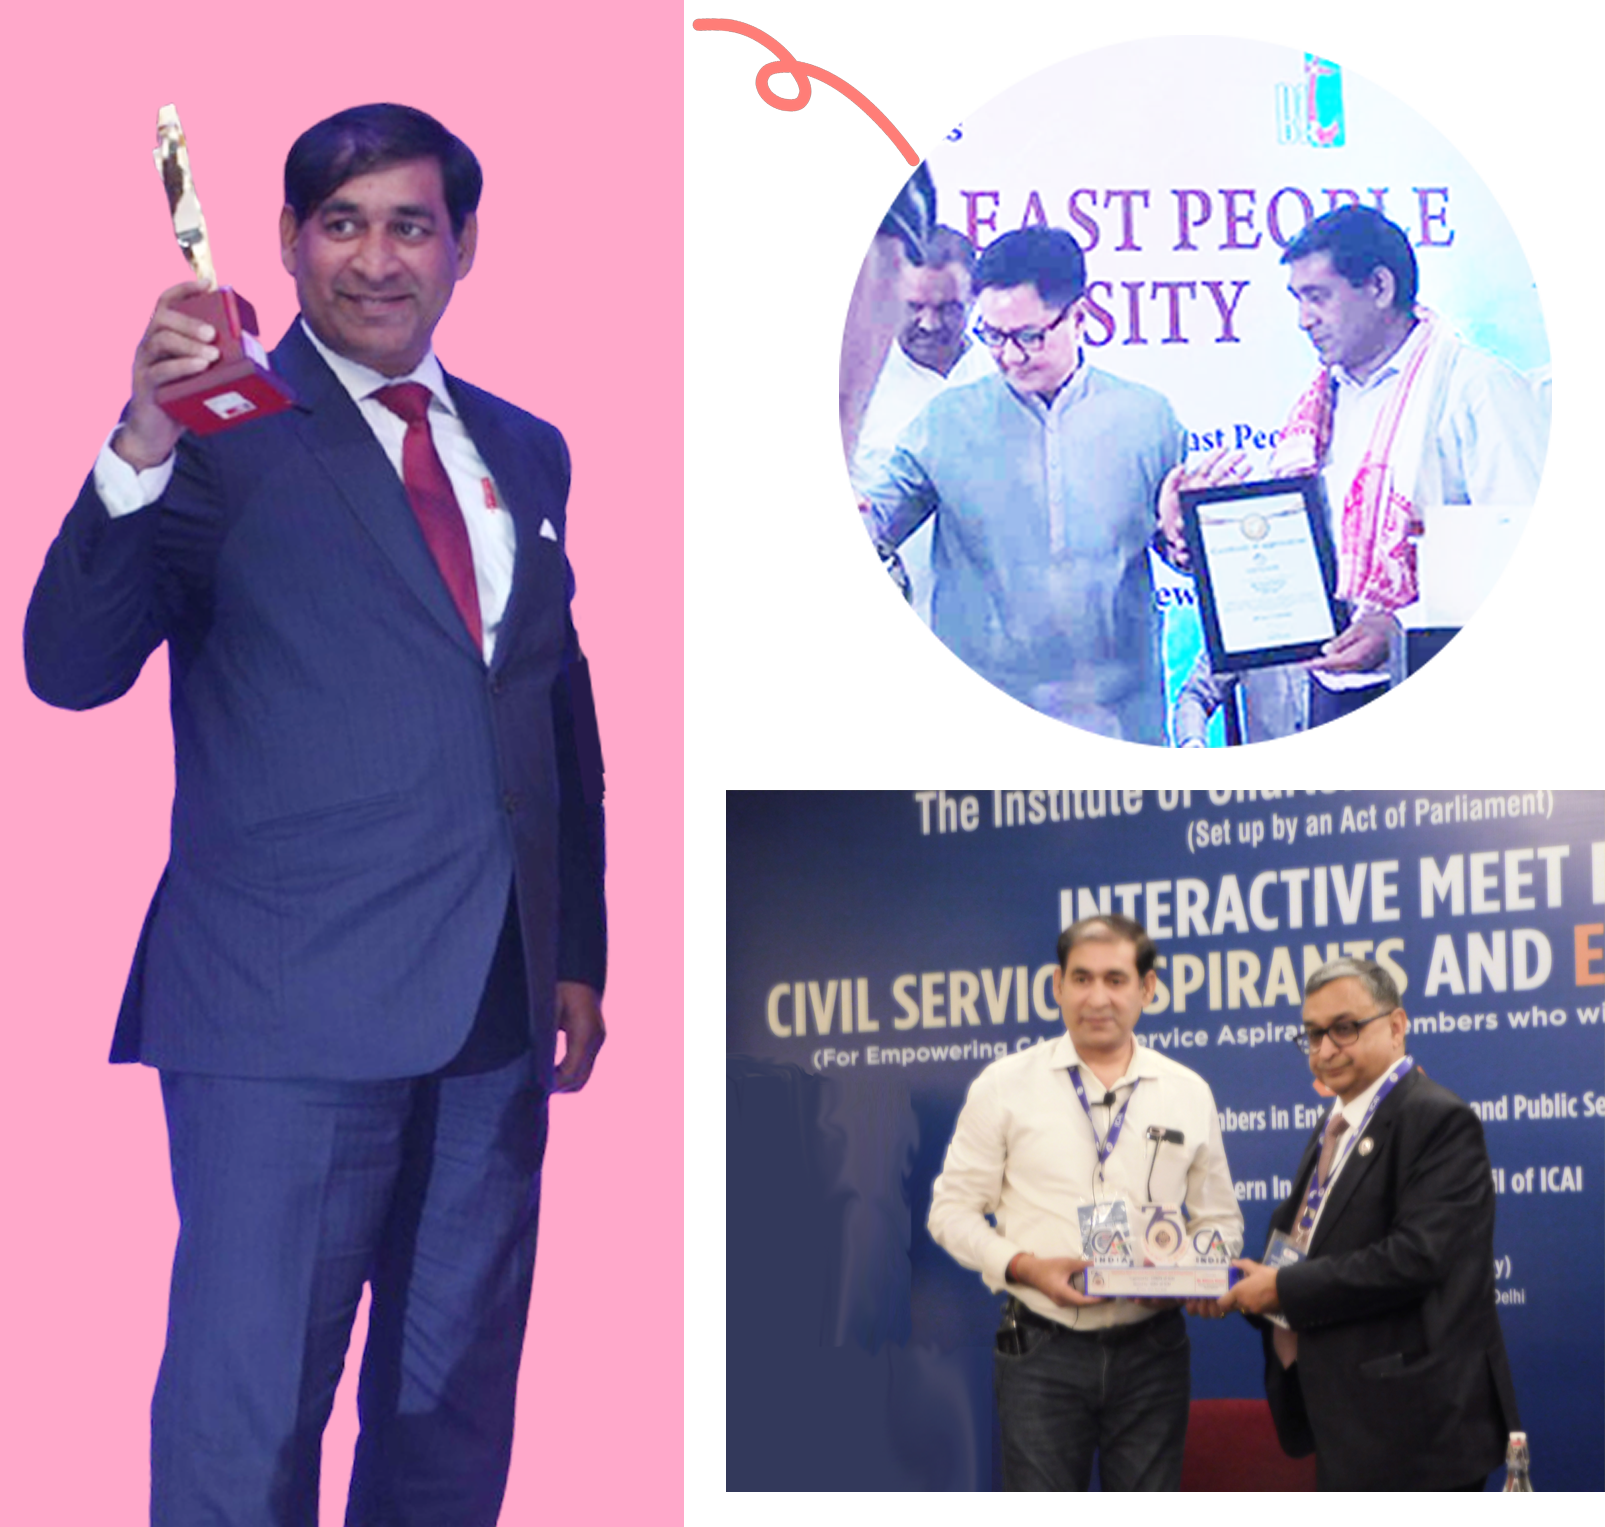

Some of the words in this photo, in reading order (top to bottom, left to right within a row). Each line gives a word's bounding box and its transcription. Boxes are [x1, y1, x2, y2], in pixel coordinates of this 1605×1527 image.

[960, 187, 1150, 253] EAST
[1080, 280, 1251, 346] SITY
[915, 790, 980, 836] The
[994, 790, 1144, 828] Institute
[1187, 818, 1232, 854] (Set
[1238, 819, 1265, 848] up
[1272, 812, 1298, 845] by
[1306, 812, 1333, 837] an
[1340, 803, 1378, 834] Act
[1385, 799, 1407, 829] of
[1415, 790, 1554, 827] Parliament)
[1059, 859, 1401, 940] INTERACTIVE
[1419, 844, 1570, 919] MEET
[766, 976, 880, 1038] CIVIL
[1424, 927, 1553, 998] AND
[813, 1048, 860, 1071] (For
[866, 1039, 1007, 1067] Empowering
[1507, 1005, 1568, 1029] who
[1271, 1105, 1289, 1130] in
[1514, 1091, 1578, 1120] Public
[1511, 1166, 1534, 1194] of
[1540, 1165, 1583, 1193] ICAI
[1196, 1256, 1229, 1264] INDIA
